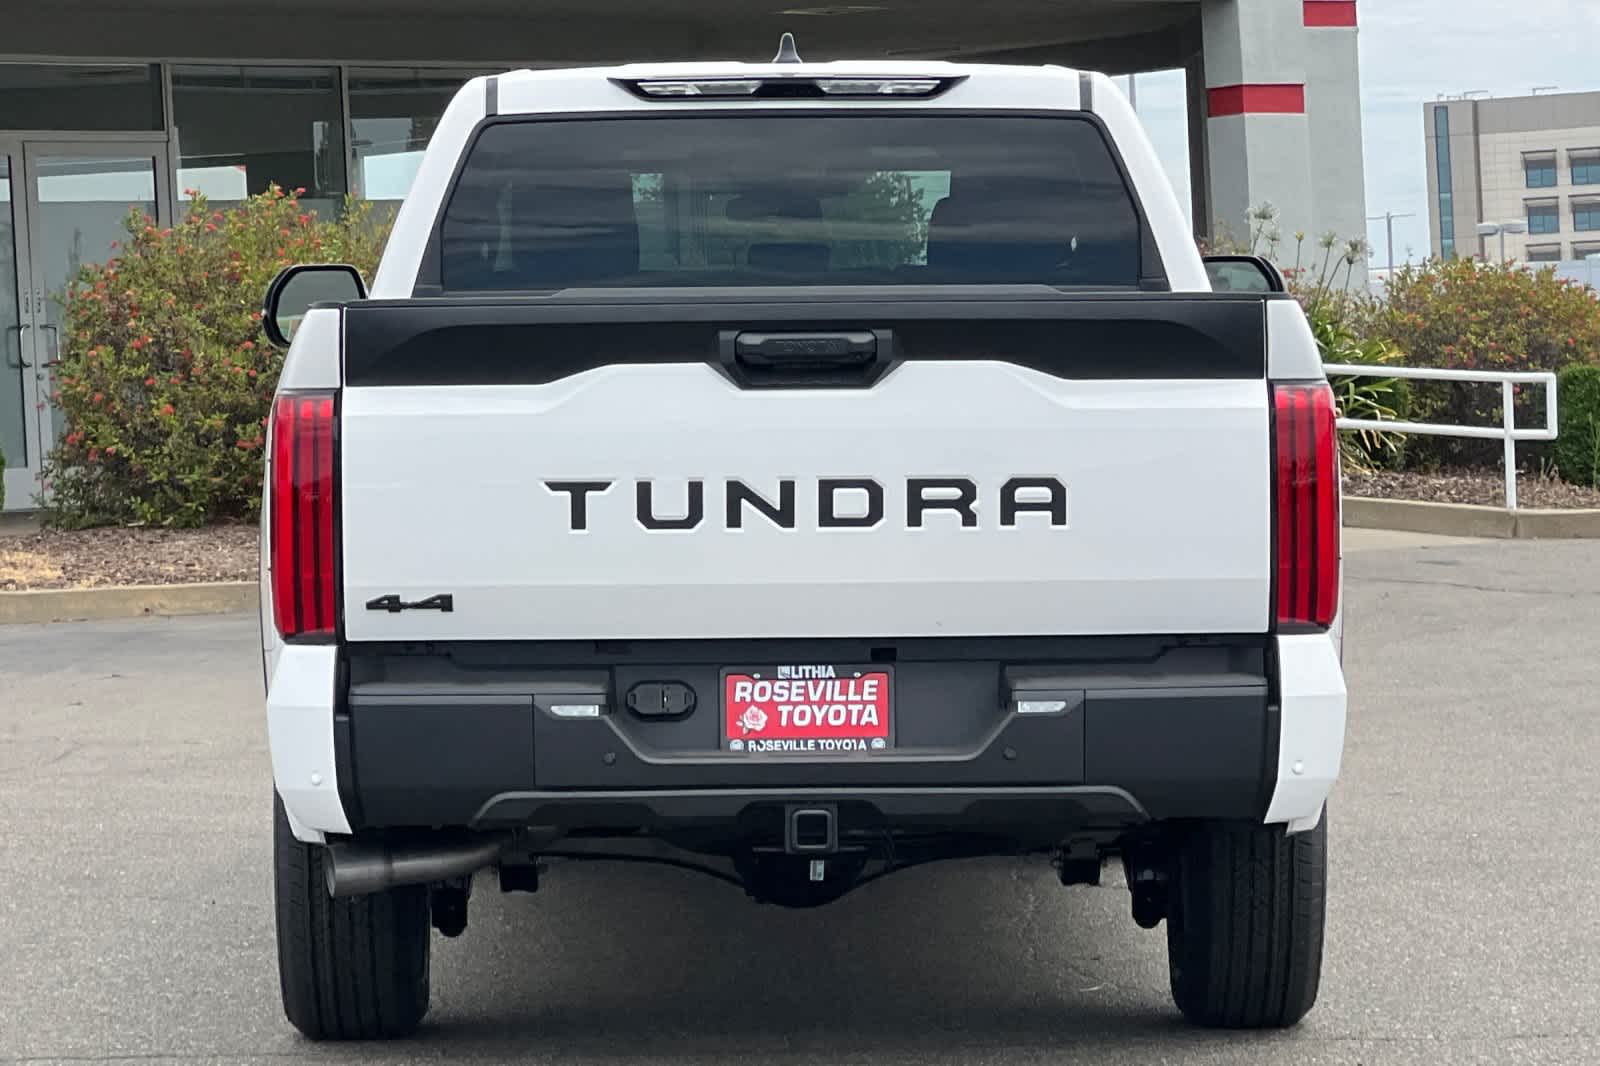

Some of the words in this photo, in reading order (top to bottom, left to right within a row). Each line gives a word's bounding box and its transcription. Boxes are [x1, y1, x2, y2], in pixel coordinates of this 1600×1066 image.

[541, 475, 1069, 531] TUNDRA
[791, 665, 836, 679] LITHIA
[734, 679, 879, 703] ROSEVILLE
[777, 704, 879, 727] TOYOTA
[748, 739, 816, 752] ROSEVILLE
[818, 738, 868, 752] TOYOTA
